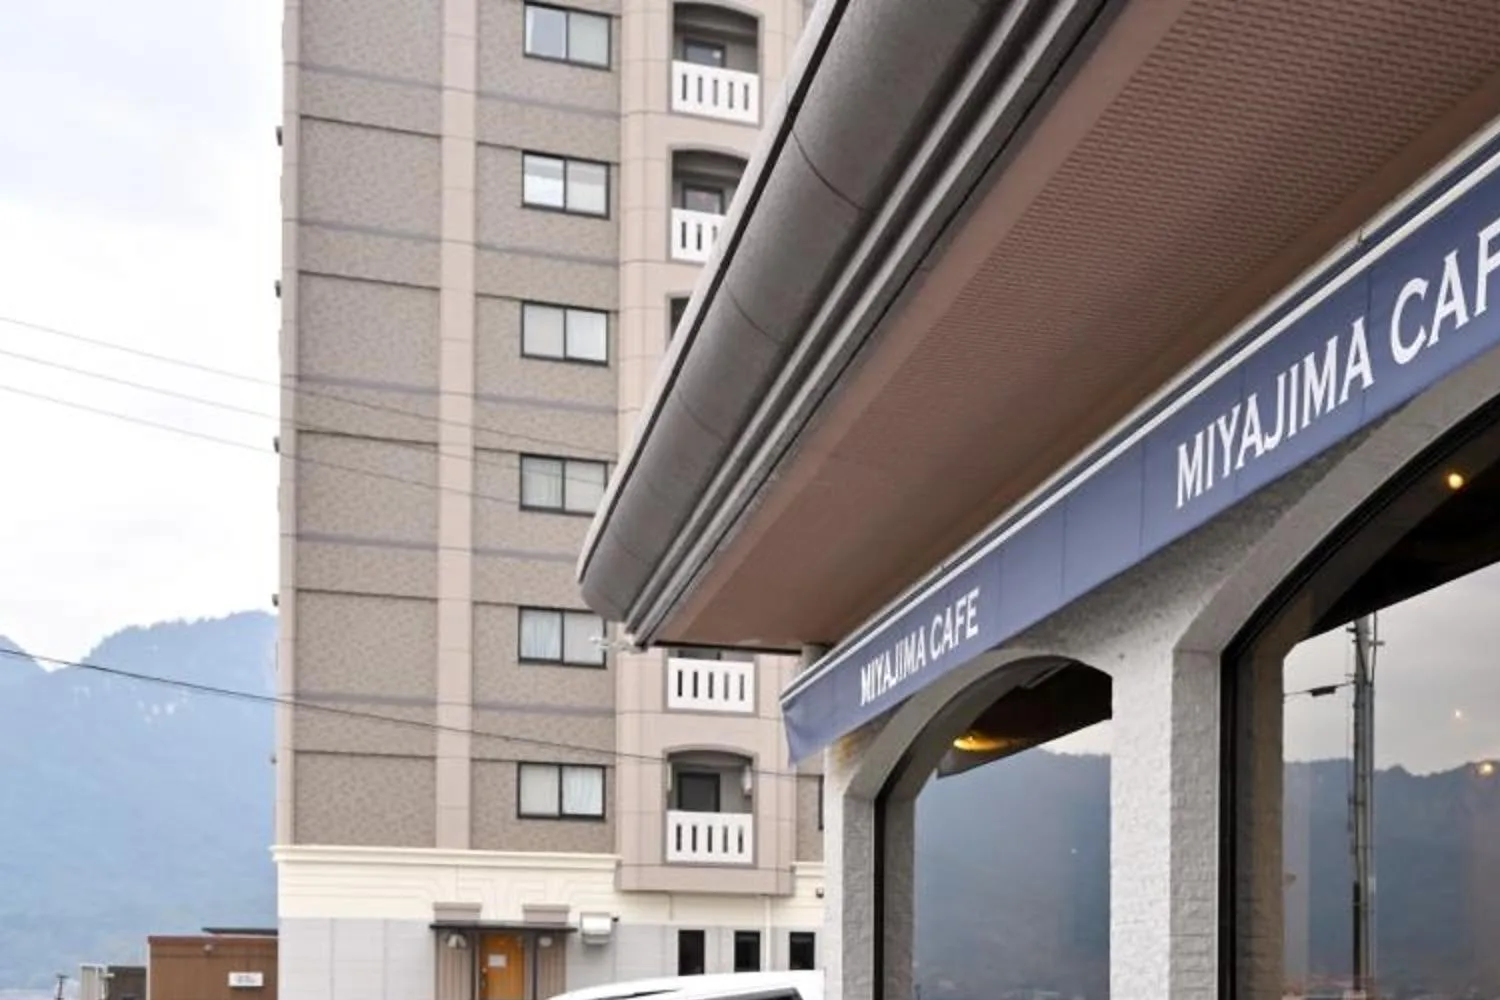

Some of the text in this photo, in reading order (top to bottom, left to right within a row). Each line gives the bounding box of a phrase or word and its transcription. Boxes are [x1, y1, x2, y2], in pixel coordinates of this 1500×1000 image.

[1176, 316, 1375, 509] MIYAJIMA
[860, 586, 980, 707] MIYAJIMA CAFE
